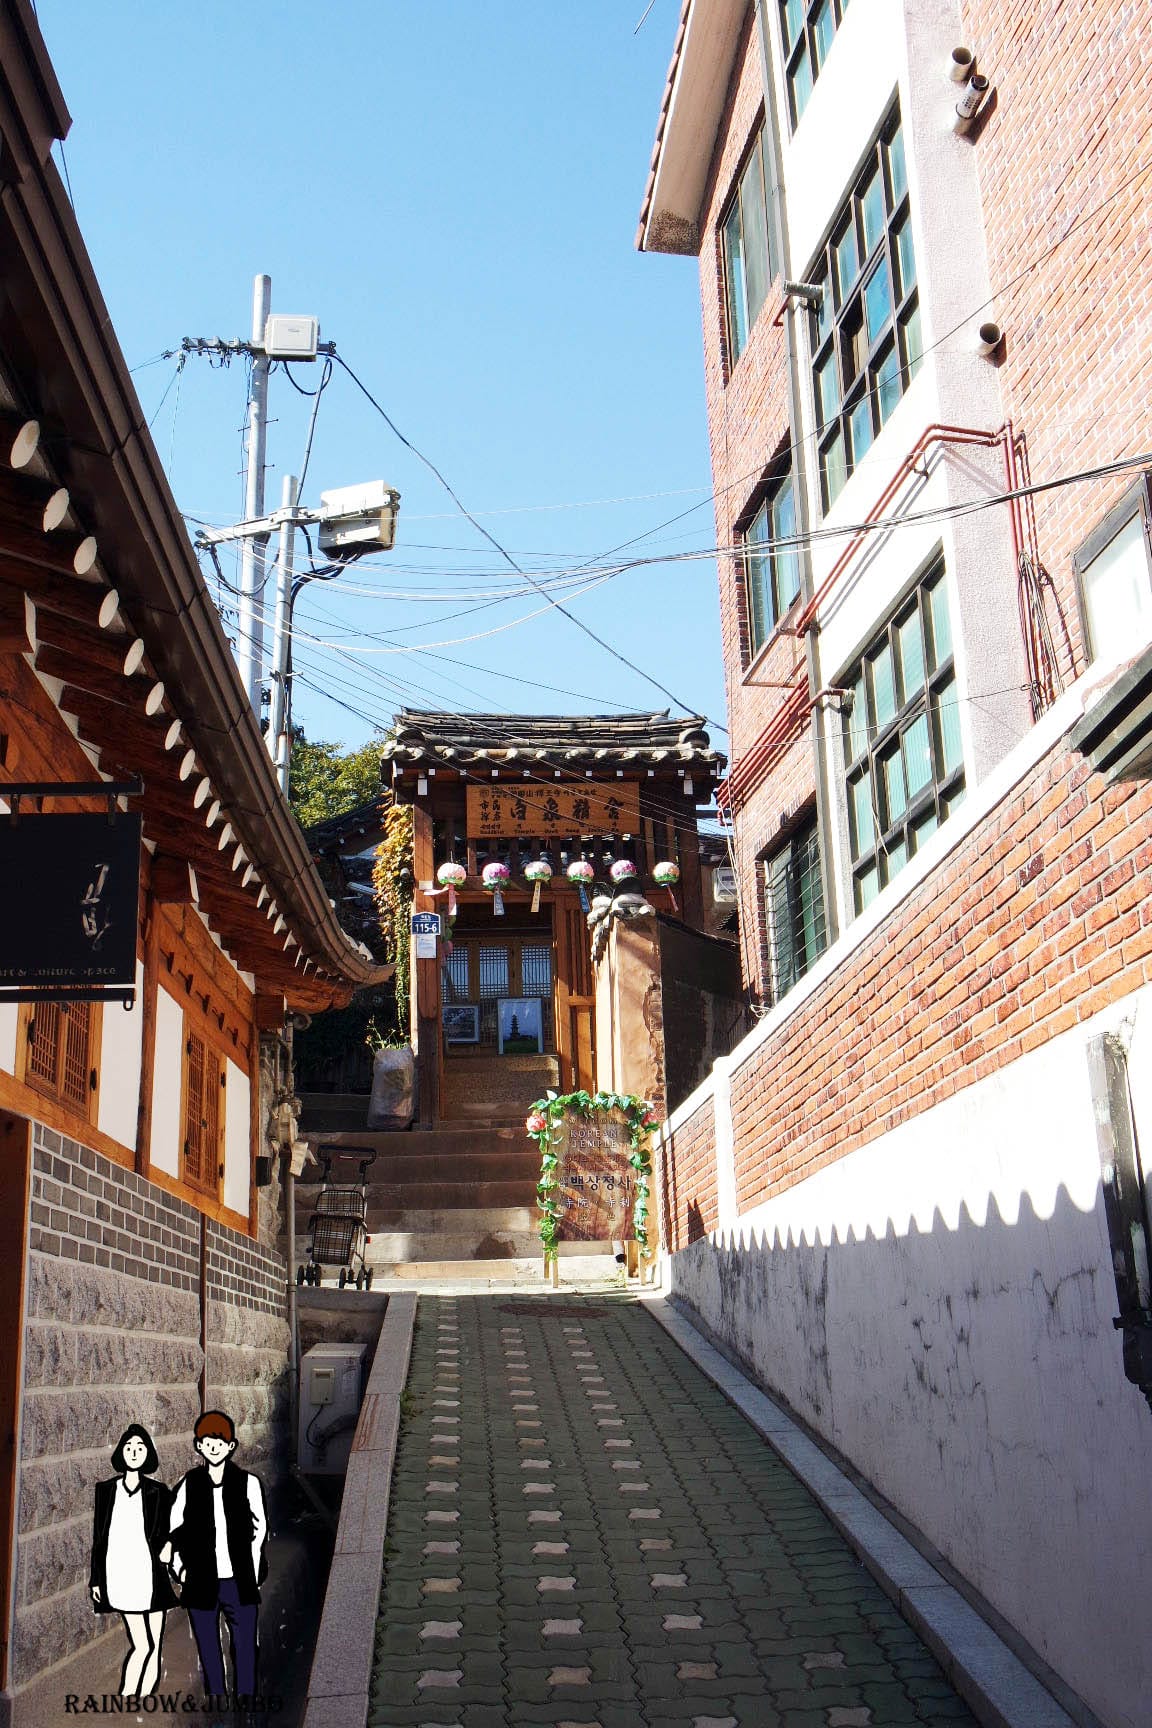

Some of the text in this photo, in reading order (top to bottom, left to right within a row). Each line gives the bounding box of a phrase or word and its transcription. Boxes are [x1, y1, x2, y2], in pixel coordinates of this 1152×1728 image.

[415, 923, 437, 933] 115-6
[570, 1129, 618, 1139] KOREAN
[570, 1175, 632, 1192] 백상정사
